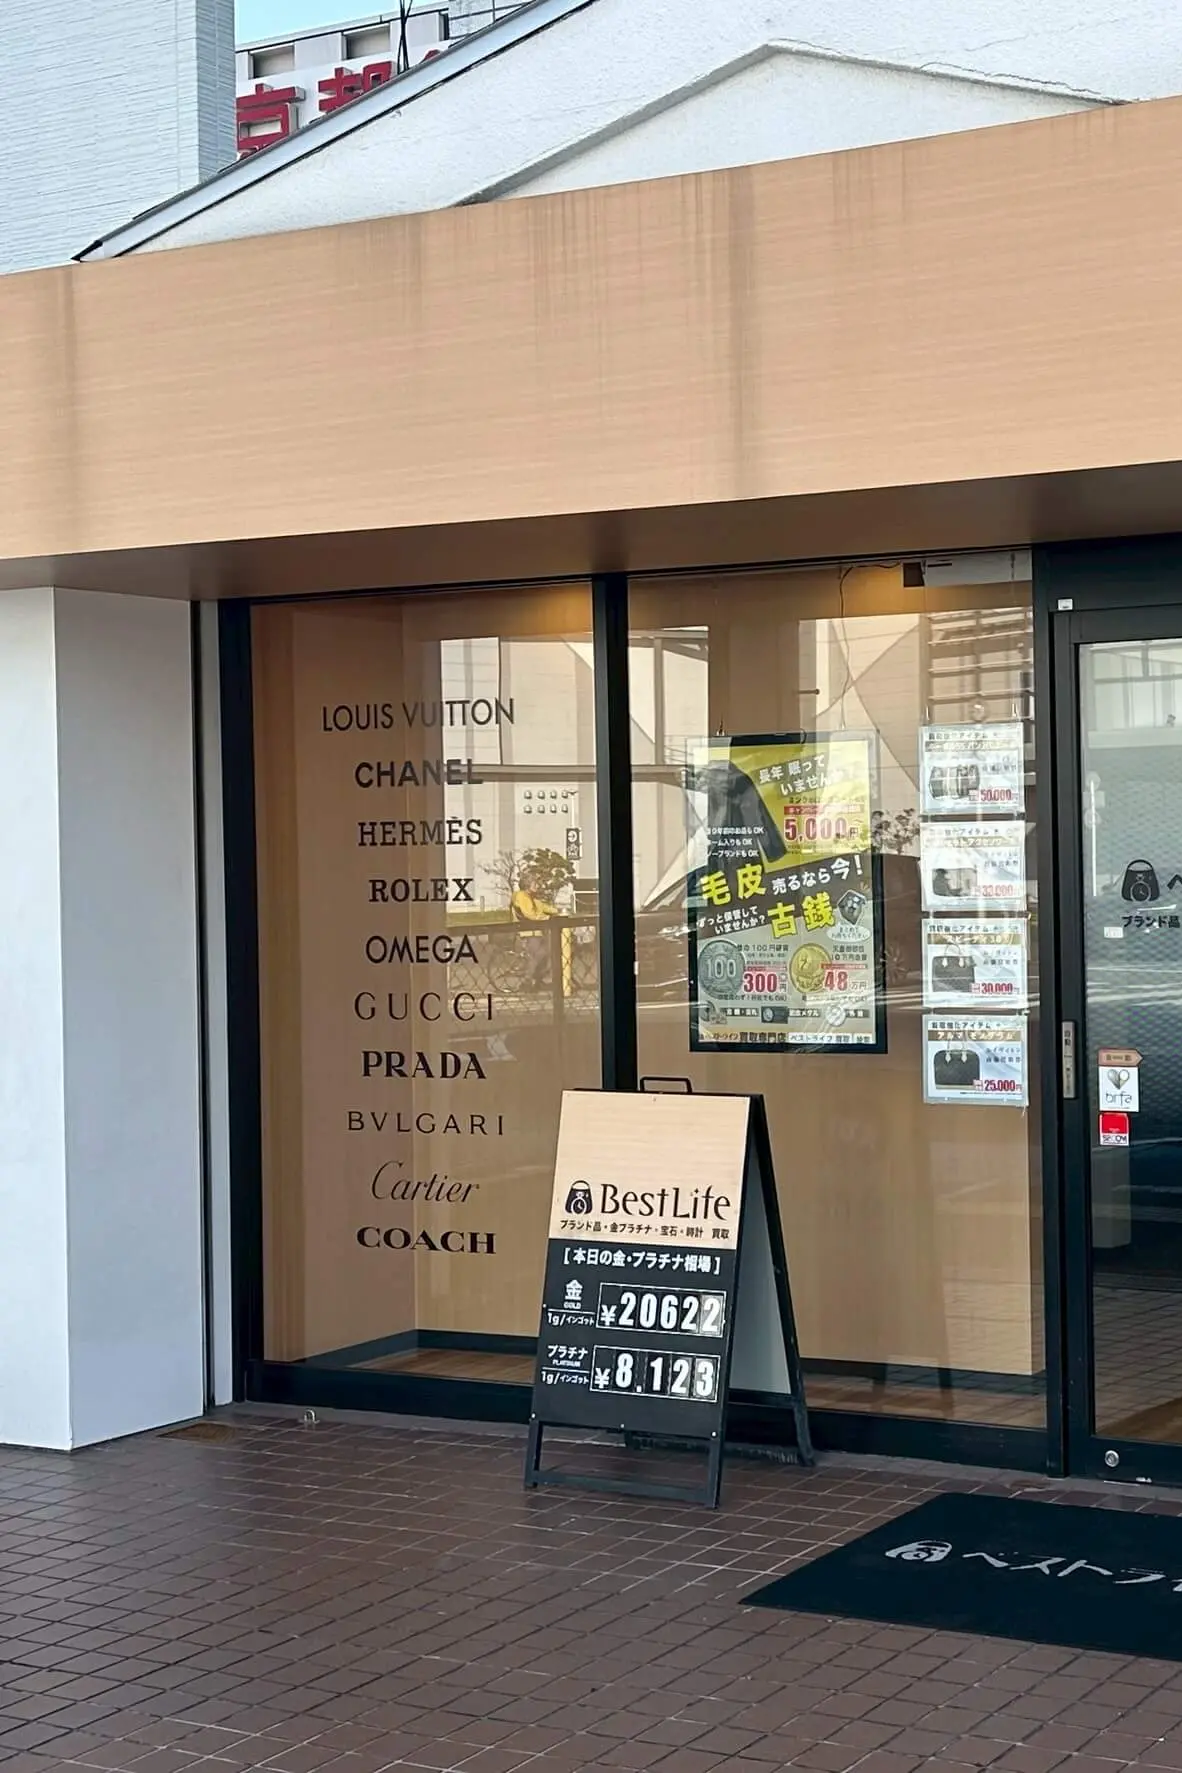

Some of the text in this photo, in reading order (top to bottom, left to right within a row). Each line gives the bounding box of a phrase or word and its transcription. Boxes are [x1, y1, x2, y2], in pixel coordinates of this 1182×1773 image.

[322, 698, 515, 732] LOUIS VUITTON
[354, 759, 484, 788] CHANEL
[369, 878, 474, 902] ROLEX
[699, 863, 767, 906] 毛皮
[767, 891, 836, 939] 古銭
[365, 934, 479, 963] OMEGA
[354, 992, 493, 1021] GUCCI
[362, 1051, 486, 1079] PRADA
[348, 1111, 503, 1135] BVLGARI
[371, 1160, 480, 1203] Cartier
[600, 1183, 731, 1221] BestLife
[356, 1226, 496, 1254] COACH
[711, 1228, 730, 1240] 買取
[565, 1279, 583, 1301] 金
[547, 1344, 588, 1359] プラチナ
